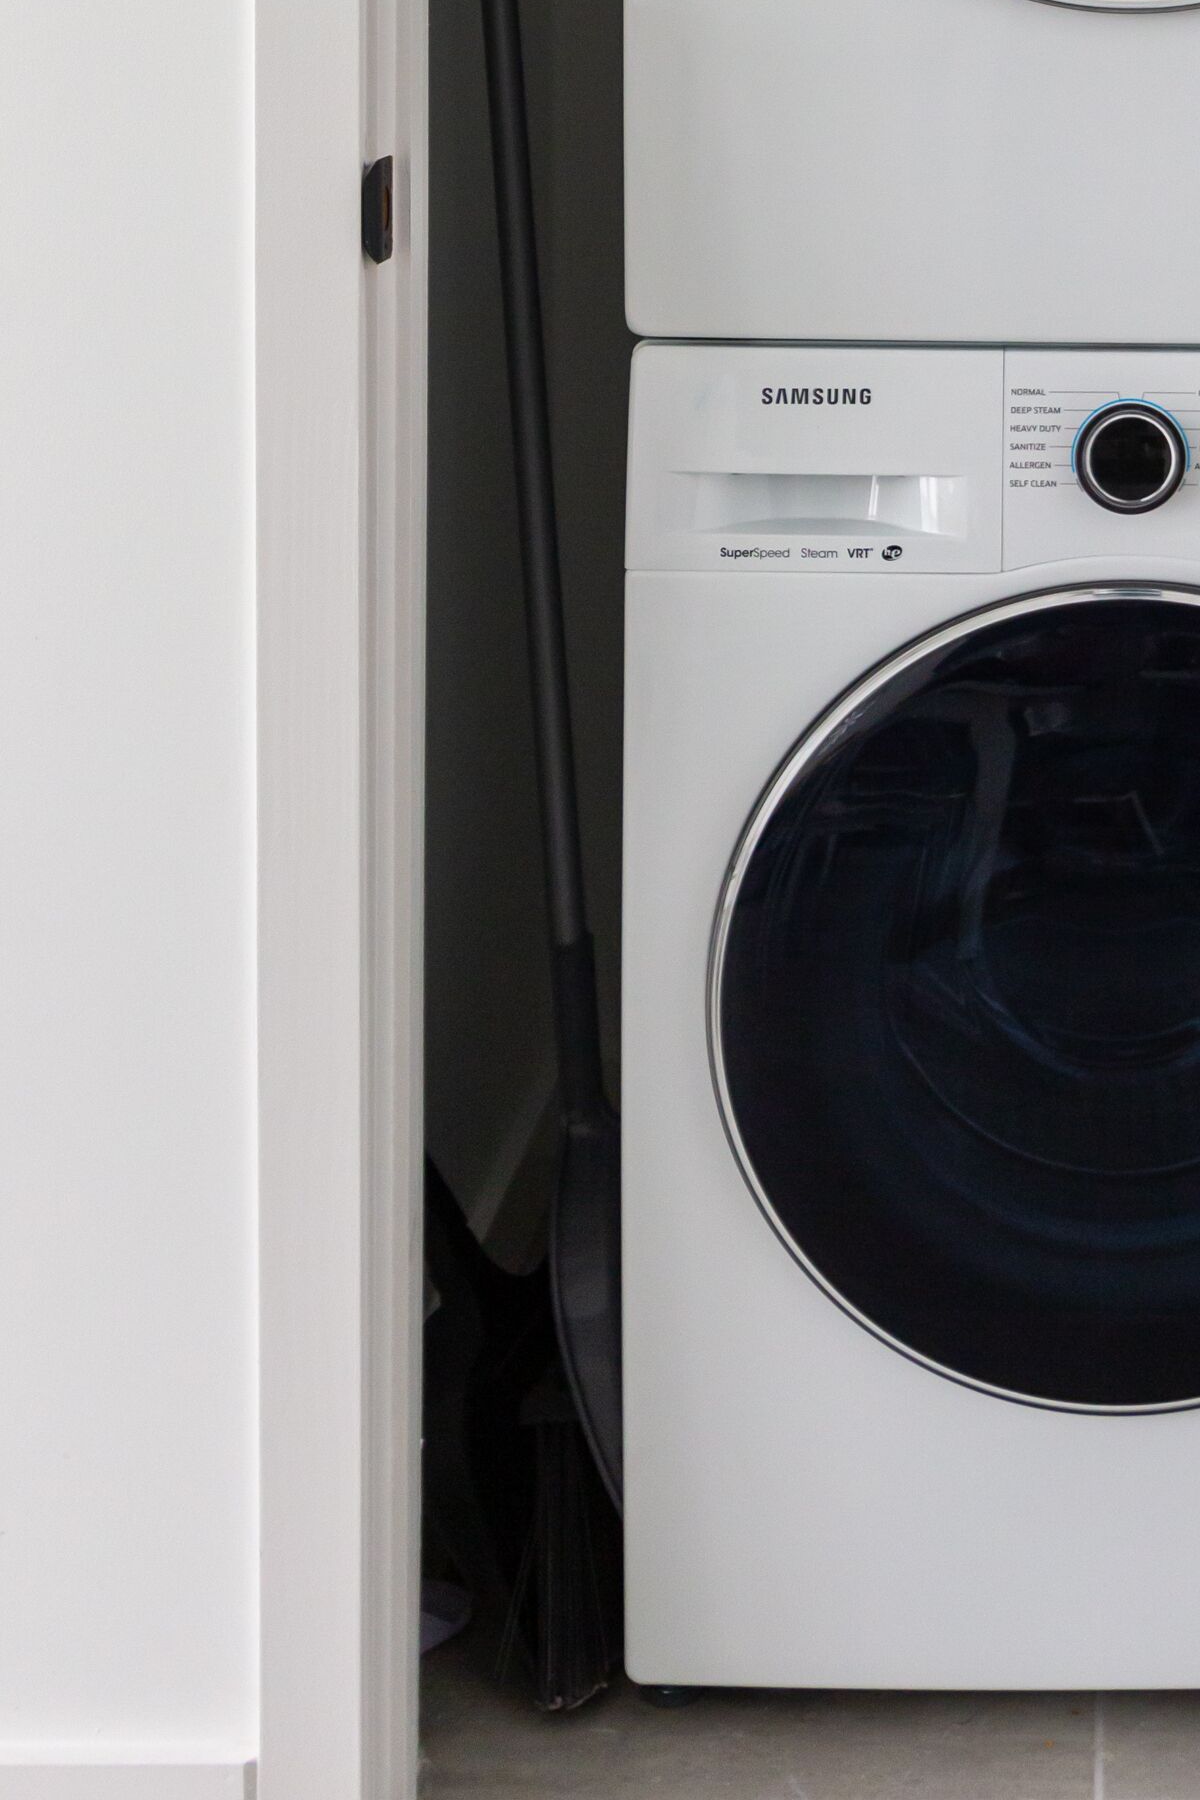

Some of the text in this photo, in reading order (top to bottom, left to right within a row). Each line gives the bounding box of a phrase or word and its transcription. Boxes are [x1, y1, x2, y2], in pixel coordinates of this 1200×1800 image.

[761, 387, 872, 405] SAMSUNG
[1011, 388, 1046, 396] NORMAL
[1011, 406, 1061, 414] DEEP STEAM
[1010, 425, 1061, 433] HEAVY DUTY
[1010, 443, 1046, 451] SANITIZE
[1010, 461, 1051, 469] ALLERGEN
[1010, 479, 1057, 488] SELF CLEAN
[720, 547, 790, 560] SuperSpeed
[801, 547, 838, 559] Steam
